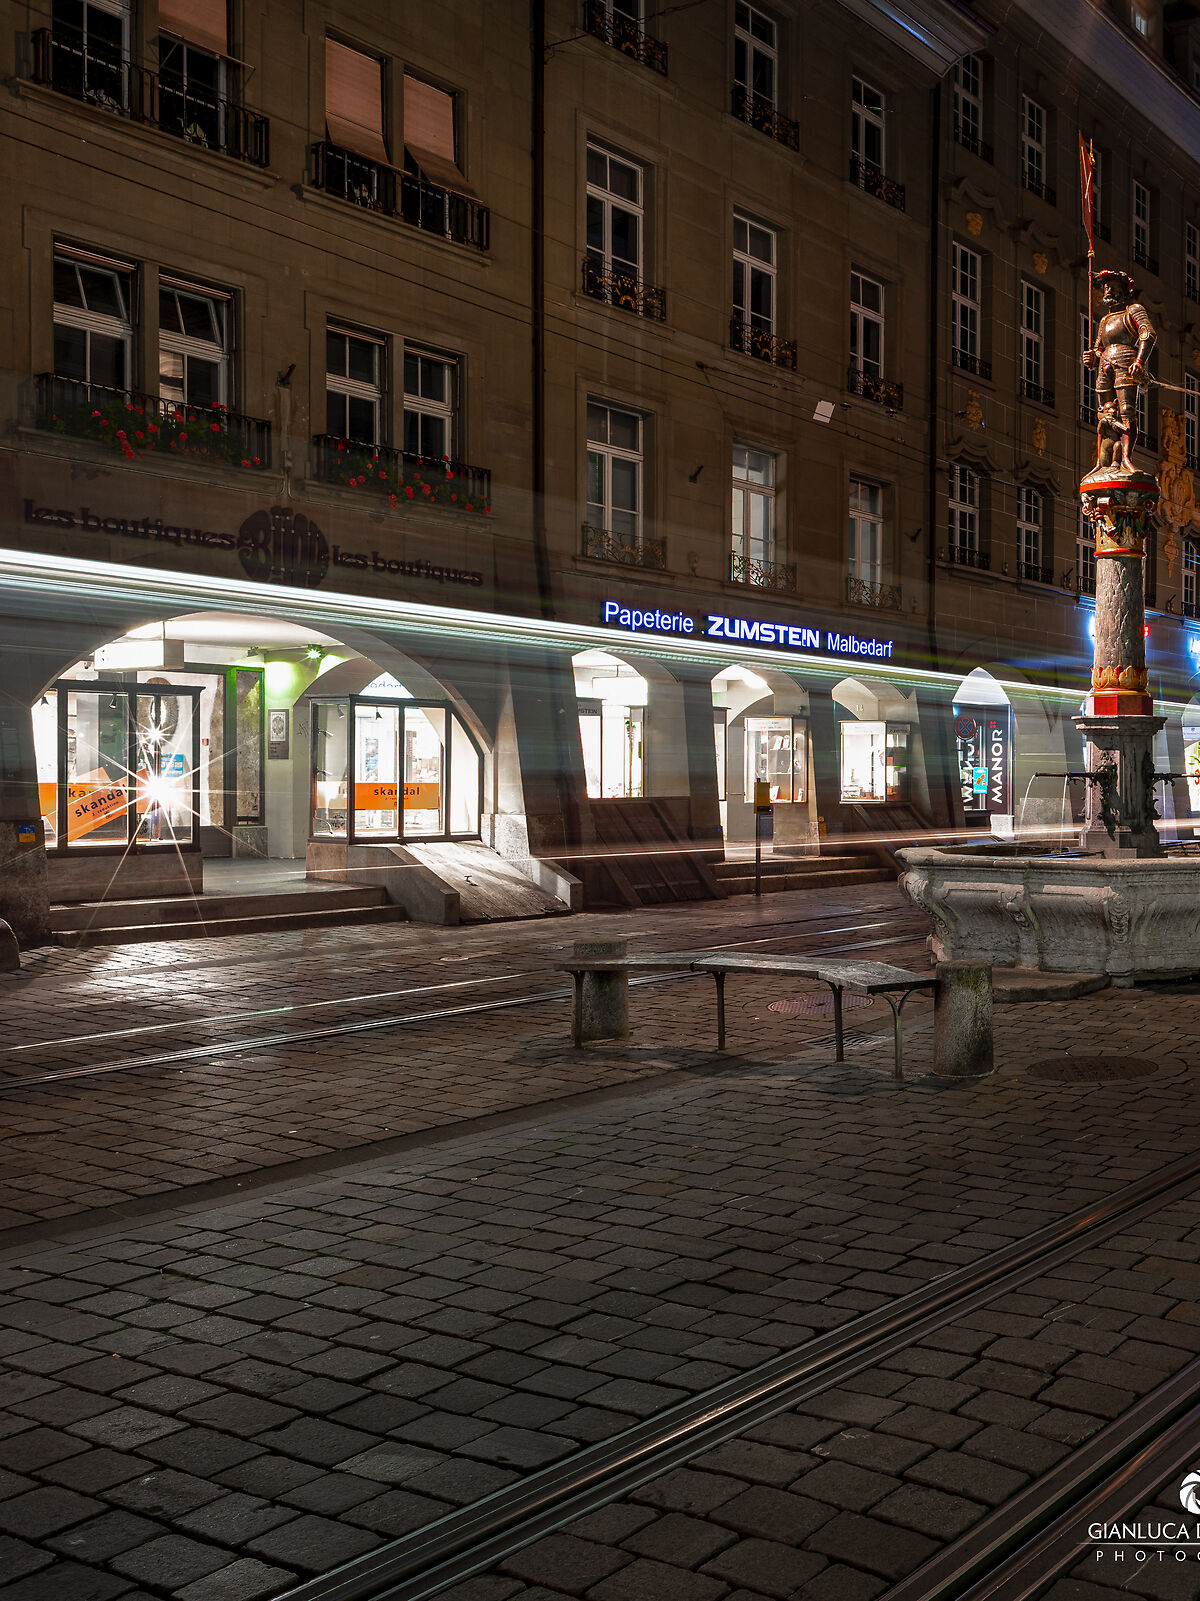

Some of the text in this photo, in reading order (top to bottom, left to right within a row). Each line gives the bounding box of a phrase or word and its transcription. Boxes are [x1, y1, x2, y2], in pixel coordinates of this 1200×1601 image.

[604, 600, 893, 658] Papeterie ZUMSTEIN Malbedarf
[991, 729, 1003, 804] MANOR
